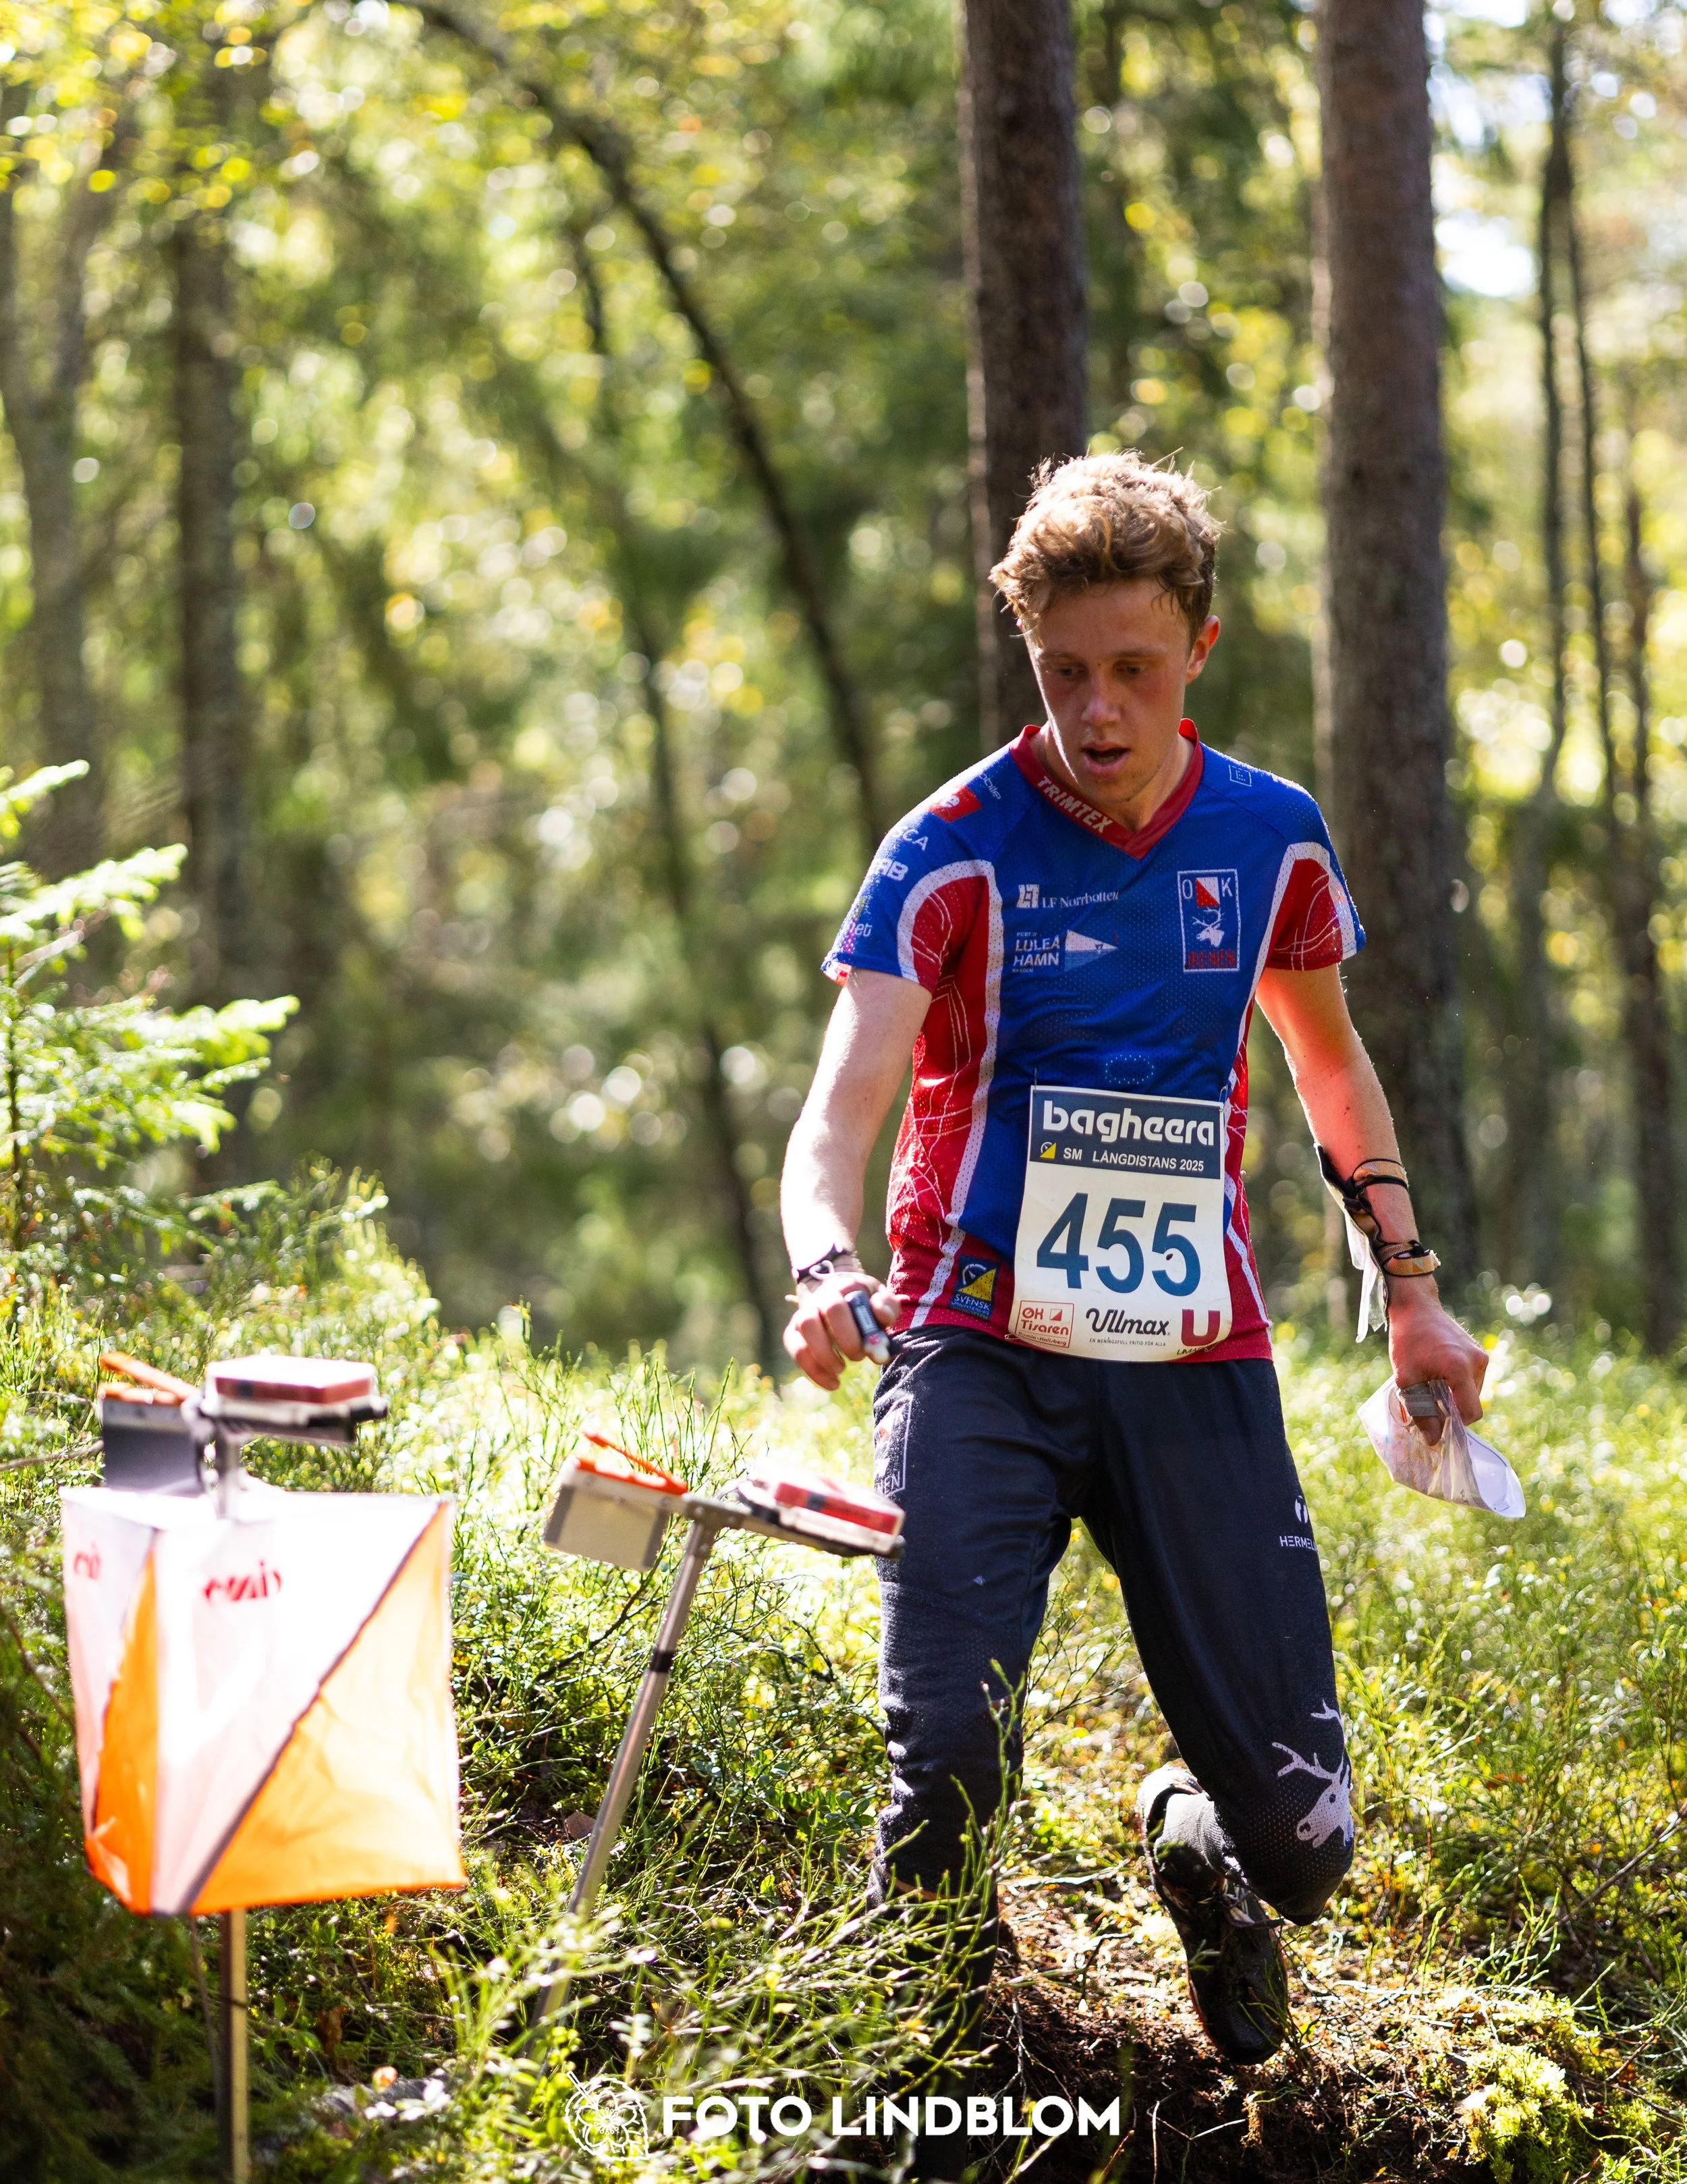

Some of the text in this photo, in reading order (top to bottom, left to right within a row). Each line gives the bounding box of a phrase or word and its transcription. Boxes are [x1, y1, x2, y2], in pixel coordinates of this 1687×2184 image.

[1037, 775, 1113, 833] TRIMTEX
[1182, 877, 1234, 899] O K
[1042, 897, 1057, 908] LF
[1013, 952, 1059, 966] HAMN
[1188, 950, 1236, 968] RENEN
[1043, 1100, 1214, 1146] bagheera
[1063, 1147, 1204, 1172] SM LÅNGDISTANS 2025
[1036, 1192, 1201, 1296] 455
[954, 1294, 991, 1310] SVENSK
[1021, 1319, 1069, 1335] Tisaren
[1086, 1307, 1169, 1336] Ullmax
[1181, 1309, 1221, 1346] U
